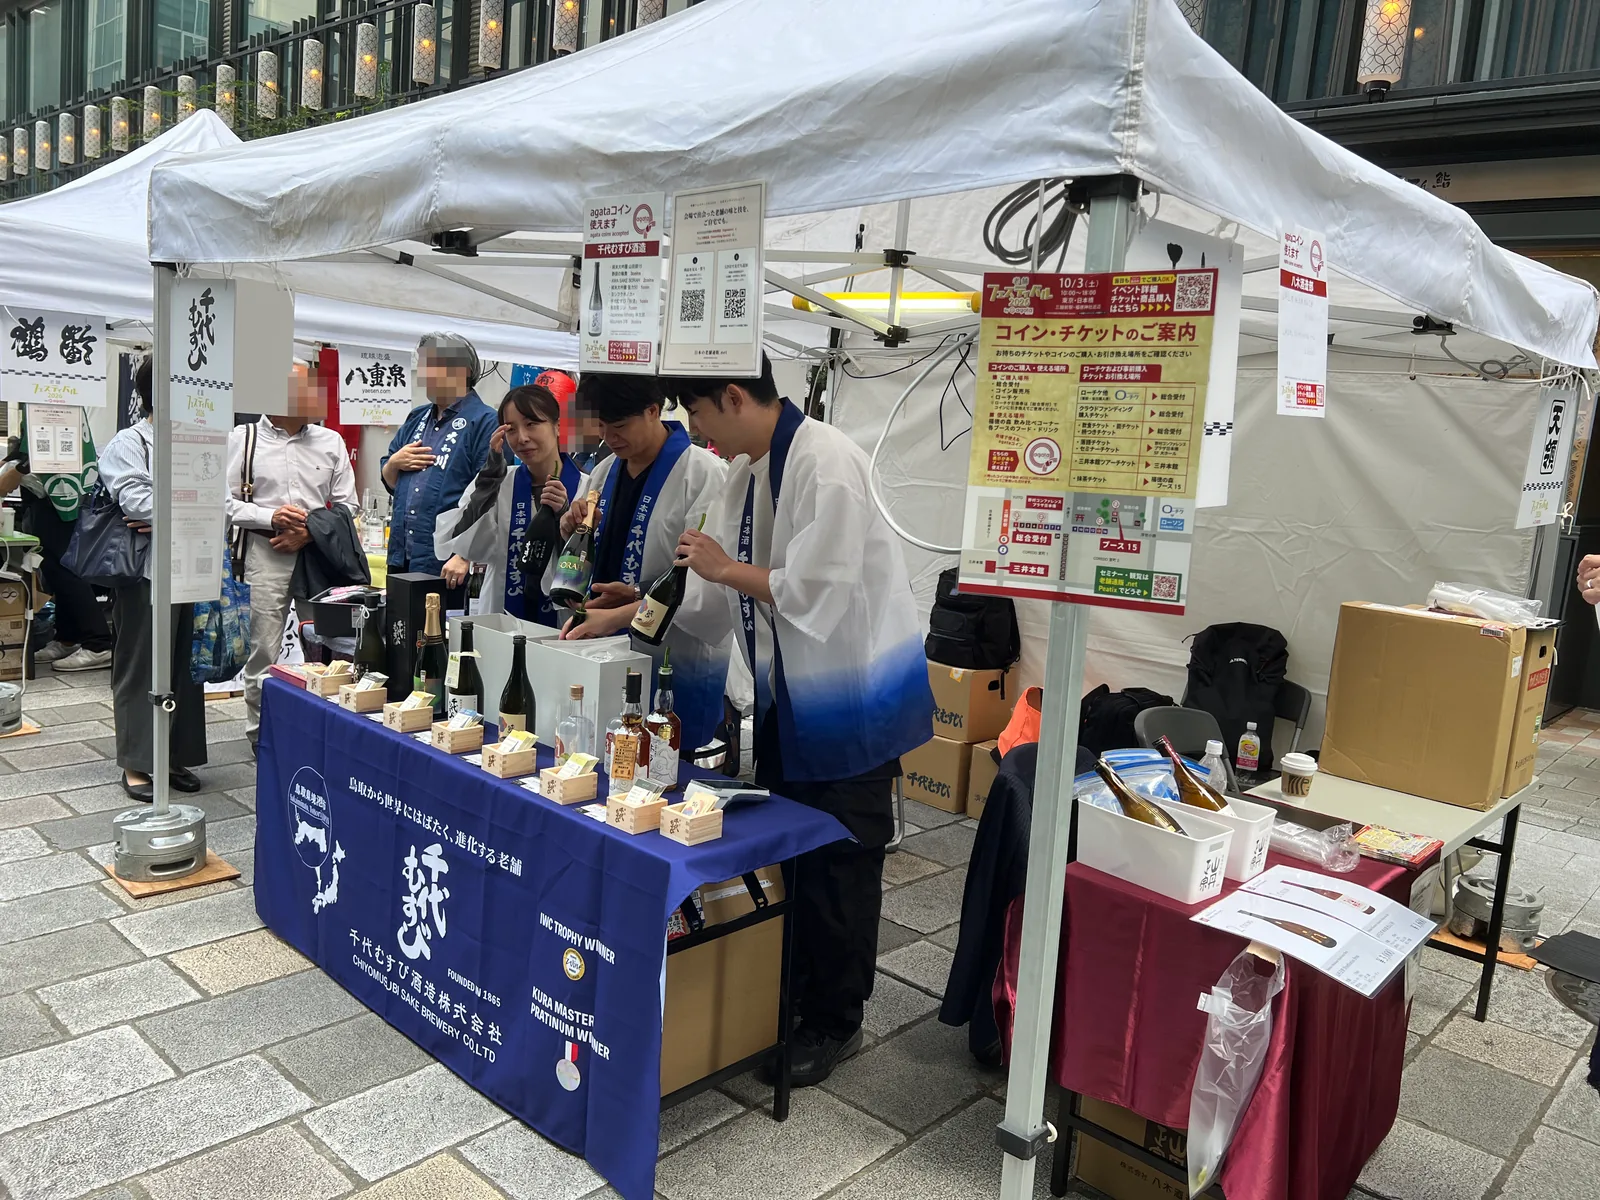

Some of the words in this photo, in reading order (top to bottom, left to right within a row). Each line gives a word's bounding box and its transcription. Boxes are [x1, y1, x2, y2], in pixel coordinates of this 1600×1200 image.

[590, 204, 632, 218] agataコイン
[590, 218, 617, 230] 使えます
[597, 243, 647, 255] 千代むすび酒造
[987, 284, 1054, 302] フェスティバル
[1111, 285, 1158, 295] イベント詳細
[1008, 297, 1031, 306] 2026
[1110, 294, 1171, 304] チケット・商品購入
[1110, 304, 1139, 313] はこちら
[996, 322, 1197, 342] コイン・チケットのご案内
[996, 349, 1192, 358] お持ちのチケットやコインのご購入・お引き換え場所をご確認ください
[991, 364, 1066, 372] コインのご購入・使える場所
[1083, 365, 1148, 373] ローチケおよび事前購入
[345, 362, 406, 388] 八重泉
[1160, 393, 1186, 401] 総合受付
[1158, 410, 1184, 418] 総合受付
[988, 425, 1059, 433] 各ブースのフード・ドリンク
[1078, 458, 1136, 467] 三井本館ツアーチケット
[515, 502, 527, 525] 日本酒
[635, 495, 652, 522] 日本酒
[741, 515, 751, 546] 日本酒
[1015, 534, 1048, 543] 総合受付
[1102, 540, 1125, 550] ブース
[1127, 543, 1138, 551] 15
[1013, 564, 1045, 574] 三井本館
[1100, 569, 1149, 580] セミナー・観覧は
[1098, 585, 1117, 593] Peatix
[1118, 587, 1142, 596] でどうぞ
[906, 771, 951, 799] 千代むすび
[349, 776, 523, 877] 鳥取から世界にはばたく、進化する老舗
[397, 843, 450, 961] 千代むすび
[540, 911, 553, 931] IWC
[554, 920, 583, 947] TROPHY
[350, 928, 503, 1046] 千代むすび酒造株式会社
[447, 968, 475, 993] FOUNDED
[482, 990, 501, 1008] 1865
[532, 985, 553, 1012] KURA
[554, 999, 595, 1028] MASTER
[400, 988, 420, 1013] SAKE
[421, 1006, 460, 1040] BREWERY
[463, 1033, 496, 1063] CO.LTD
[530, 1002, 574, 1038] PRATINUM
[1119, 1159, 1148, 1182] 株式会社
